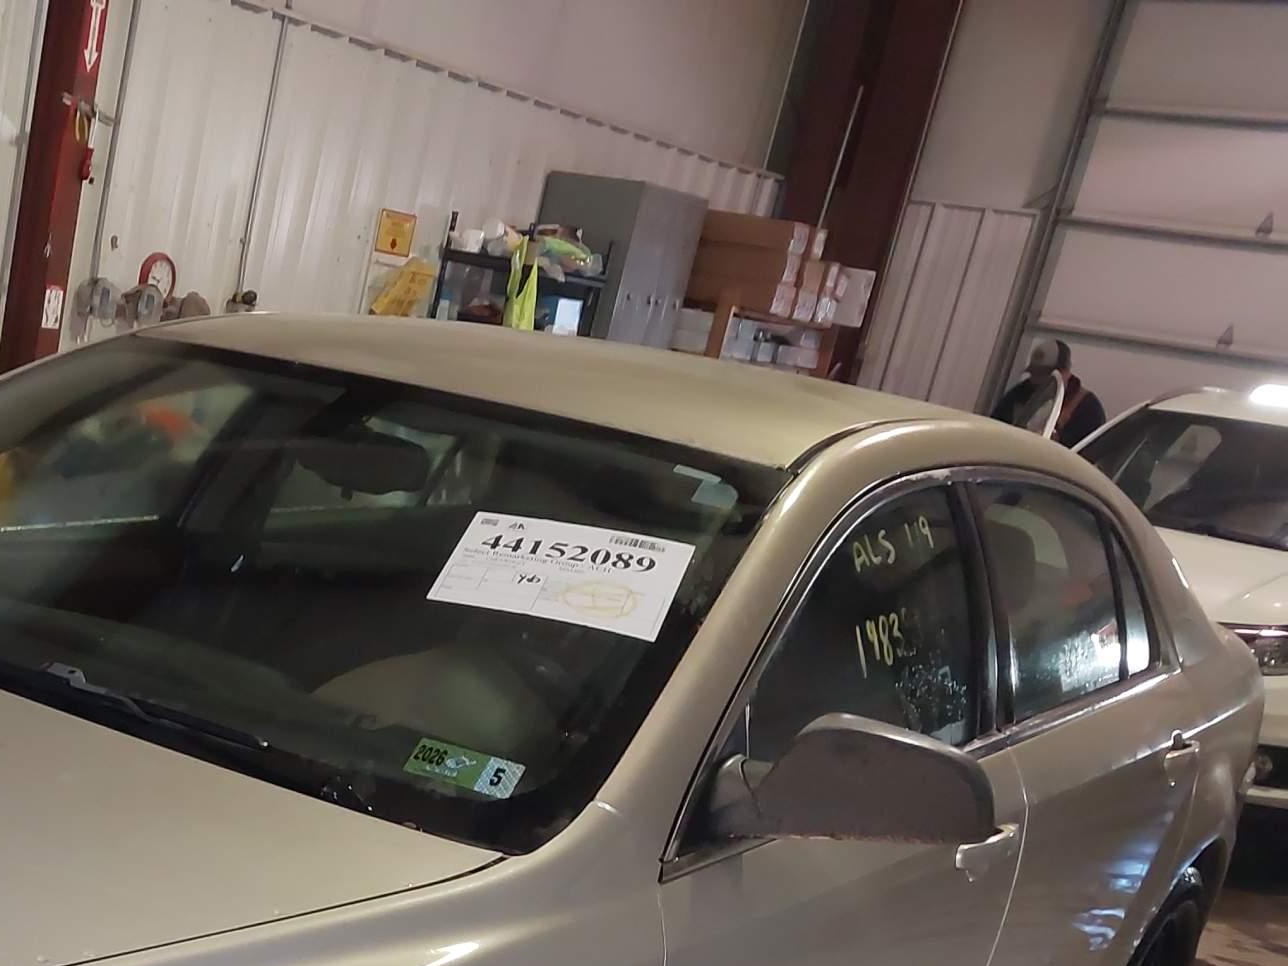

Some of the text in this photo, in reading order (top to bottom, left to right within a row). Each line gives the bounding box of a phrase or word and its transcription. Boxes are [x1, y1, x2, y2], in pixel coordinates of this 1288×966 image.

[481, 534, 656, 573] 44152089
[413, 744, 448, 766] 2026
[489, 767, 506, 786] 5
